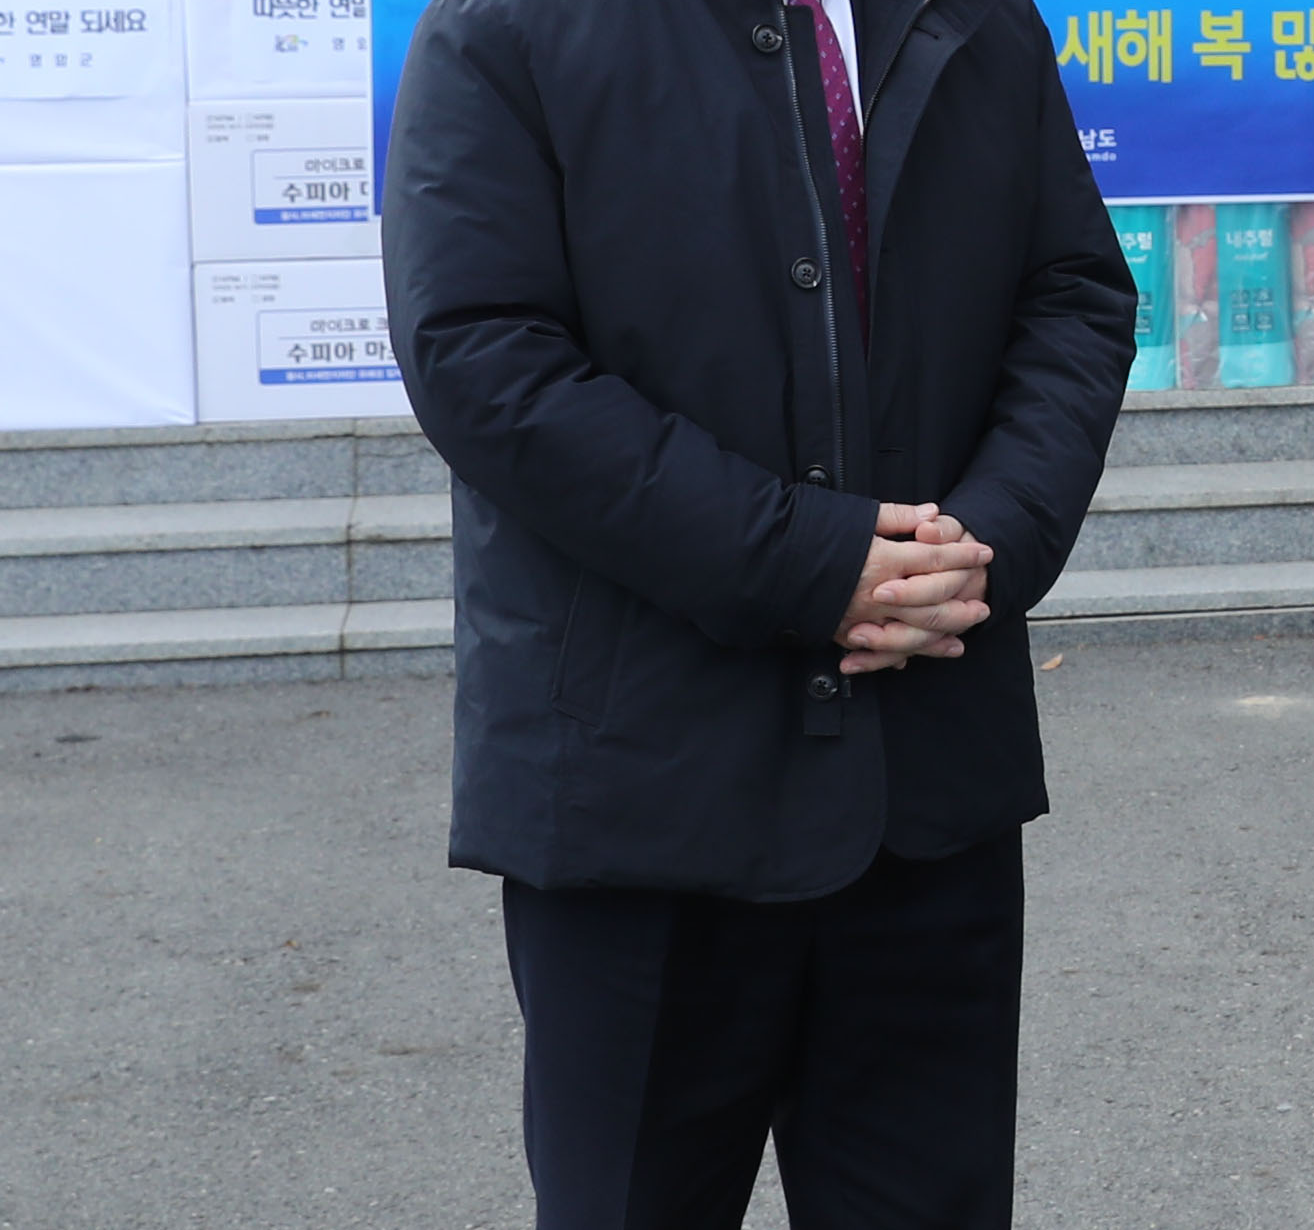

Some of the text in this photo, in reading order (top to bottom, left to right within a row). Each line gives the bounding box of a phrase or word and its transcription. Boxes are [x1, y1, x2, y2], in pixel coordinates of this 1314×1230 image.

[26, 9, 70, 36] 연말
[80, 8, 148, 33] 되세요
[1057, 9, 1174, 84] 새해
[1191, 9, 1252, 82] 복
[282, 181, 351, 203] 수피아
[1119, 231, 1154, 252] 추럴
[1225, 228, 1274, 249] 내추럴
[287, 342, 355, 364] 수피아
